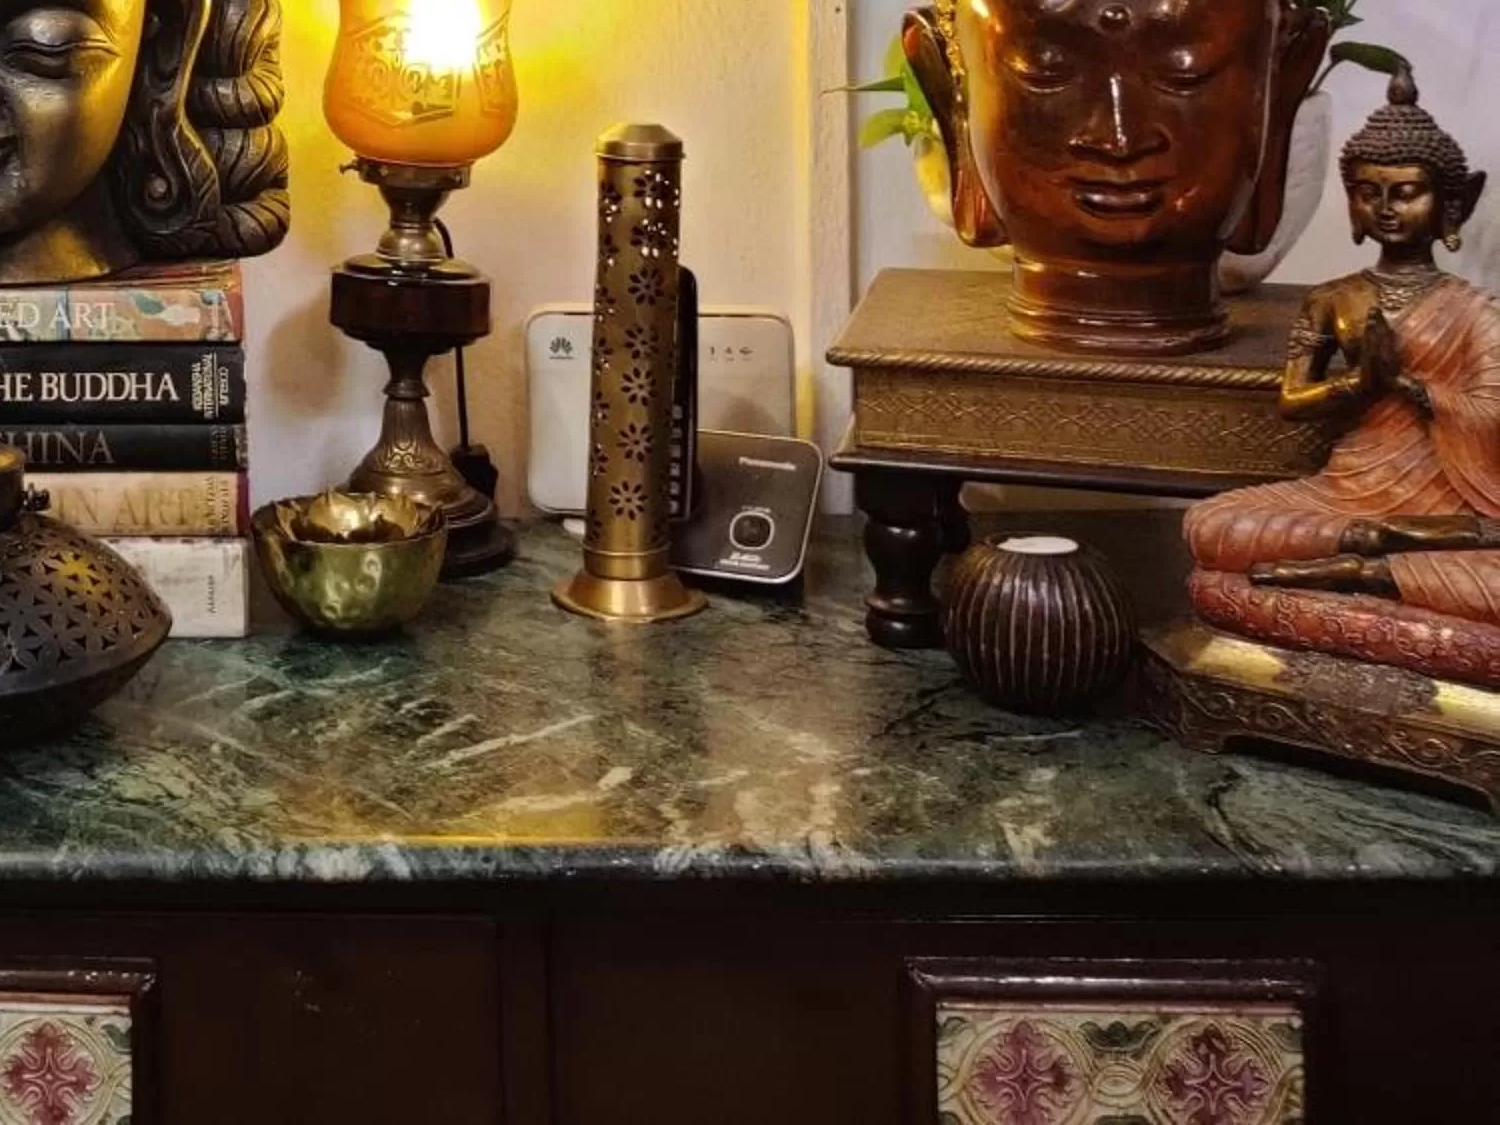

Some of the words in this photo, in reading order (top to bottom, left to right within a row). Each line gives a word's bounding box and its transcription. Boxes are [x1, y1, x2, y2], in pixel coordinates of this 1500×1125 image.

[50, 301, 116, 329] ART
[40, 372, 180, 403] BUDDHA
[53, 488, 101, 526] IN
[114, 487, 194, 530] ART
